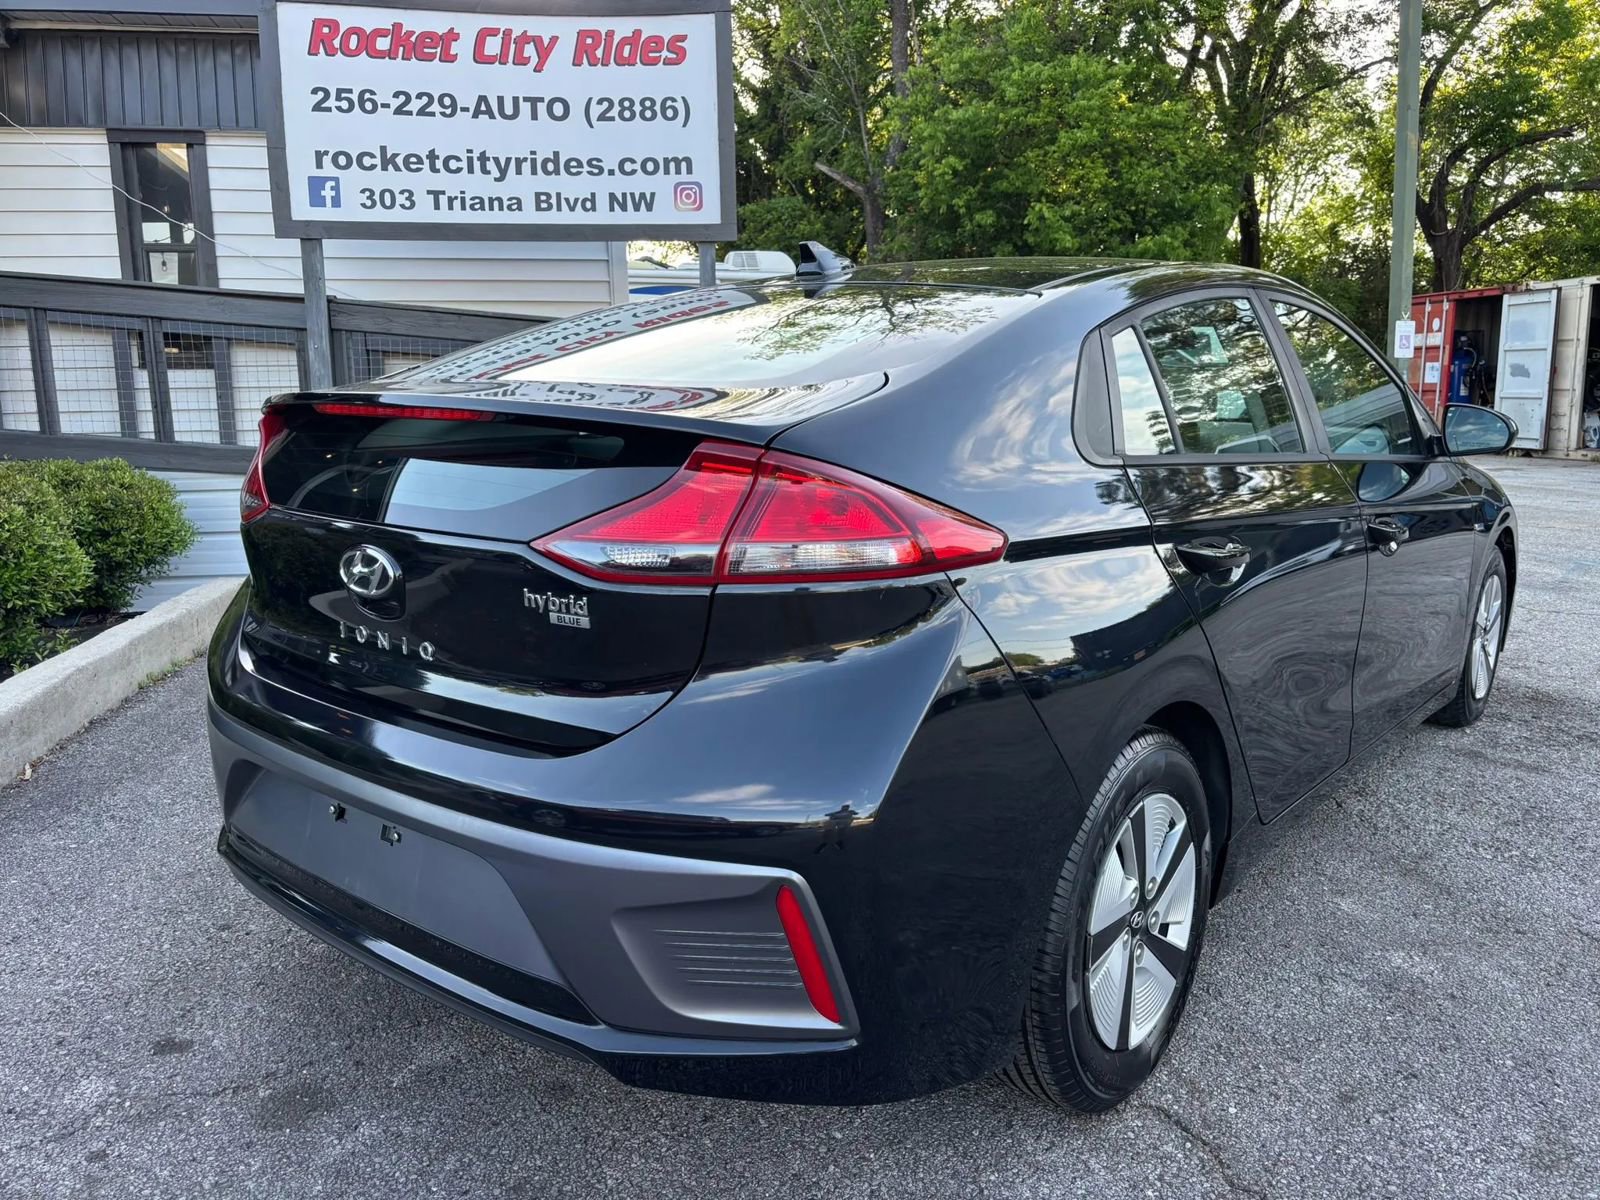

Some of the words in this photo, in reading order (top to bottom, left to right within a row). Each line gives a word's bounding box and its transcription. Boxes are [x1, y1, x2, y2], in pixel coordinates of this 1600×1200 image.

[307, 18, 460, 63] Rocket
[473, 27, 559, 73] City
[572, 29, 688, 67] Rides
[310, 86, 571, 122] 256-229-AUTO
[584, 96, 691, 128] (2886)
[313, 145, 694, 182] rocketcityrides.com
[359, 187, 416, 211] 303
[426, 189, 523, 212] Triana
[535, 191, 597, 213] Blvd
[608, 191, 656, 213] NW
[523, 588, 588, 616] hybrid
[556, 615, 582, 626] BLUE
[339, 621, 435, 661] IONIQ
